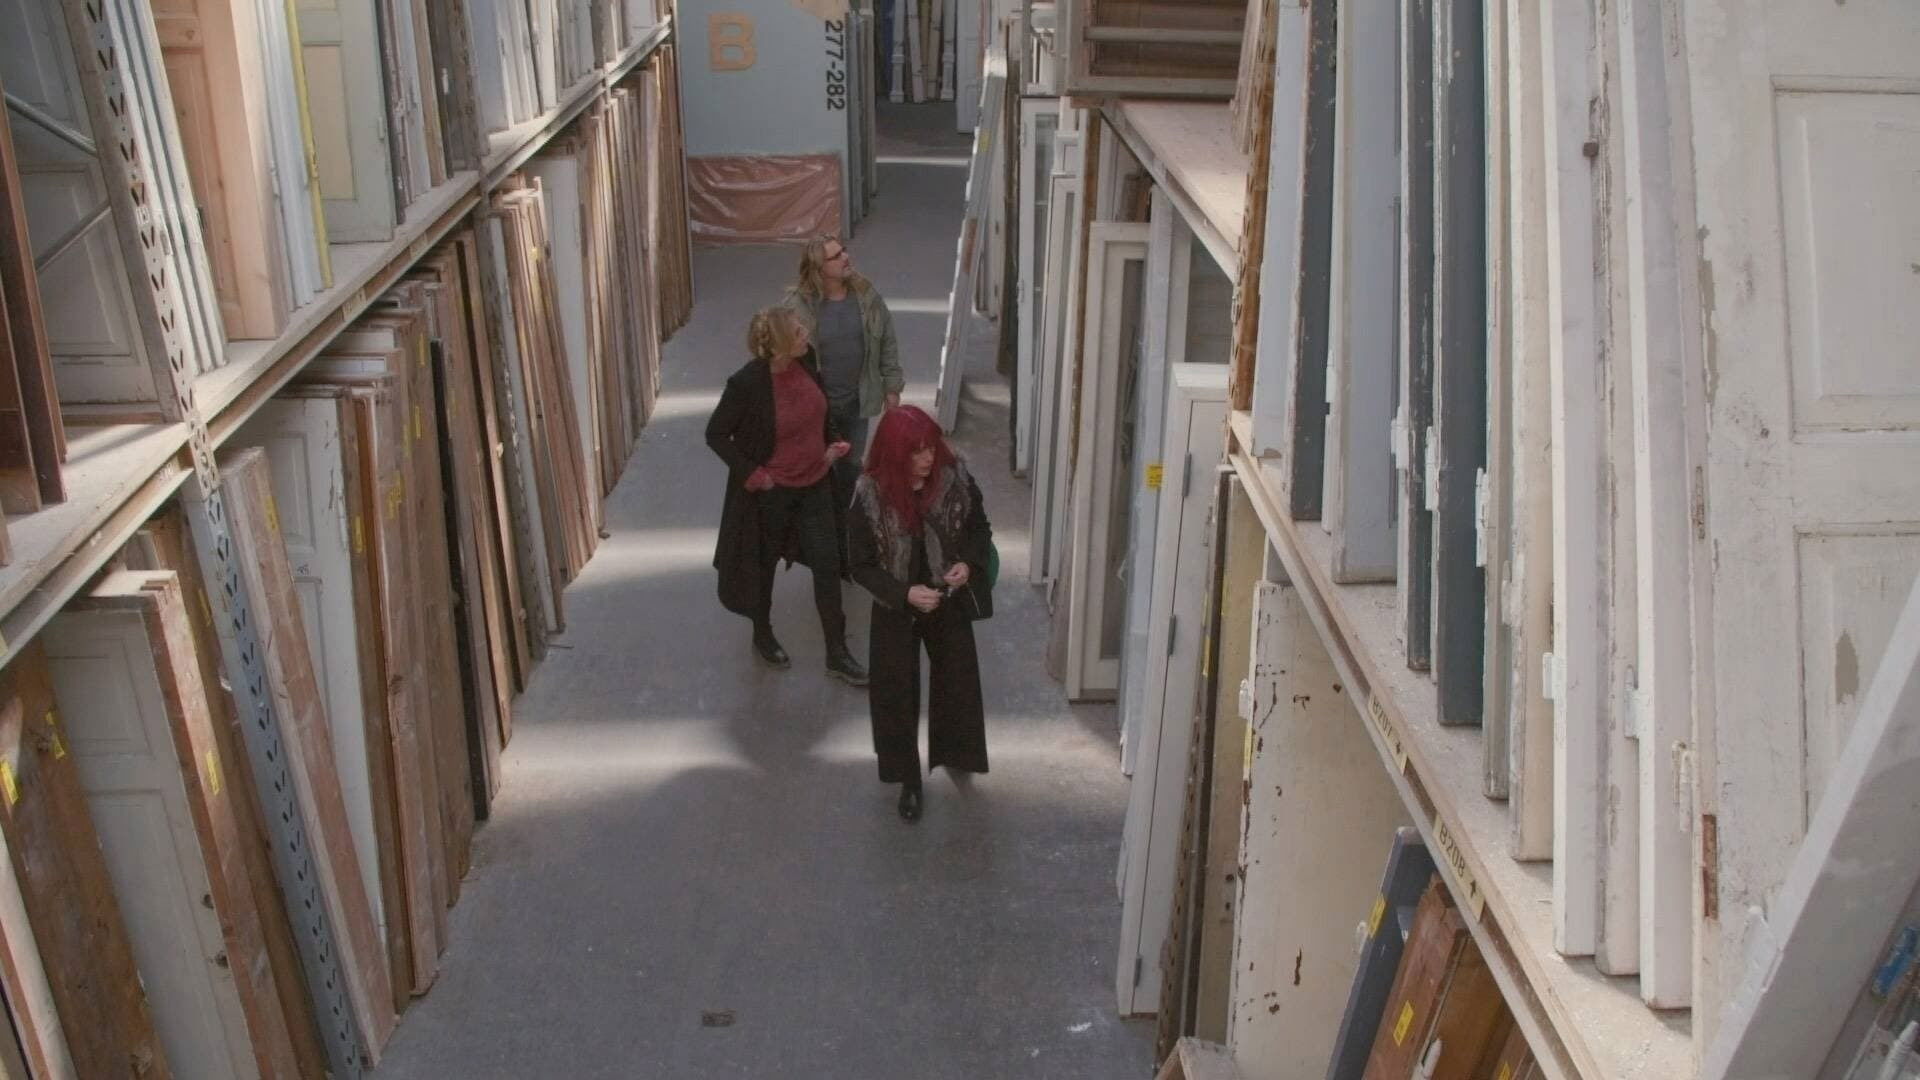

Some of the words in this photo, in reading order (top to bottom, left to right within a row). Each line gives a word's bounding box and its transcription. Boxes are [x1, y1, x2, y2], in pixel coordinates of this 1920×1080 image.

[710, 14, 757, 71] B
[824, 19, 846, 111] 277-282
[1438, 823, 1466, 878] B208
